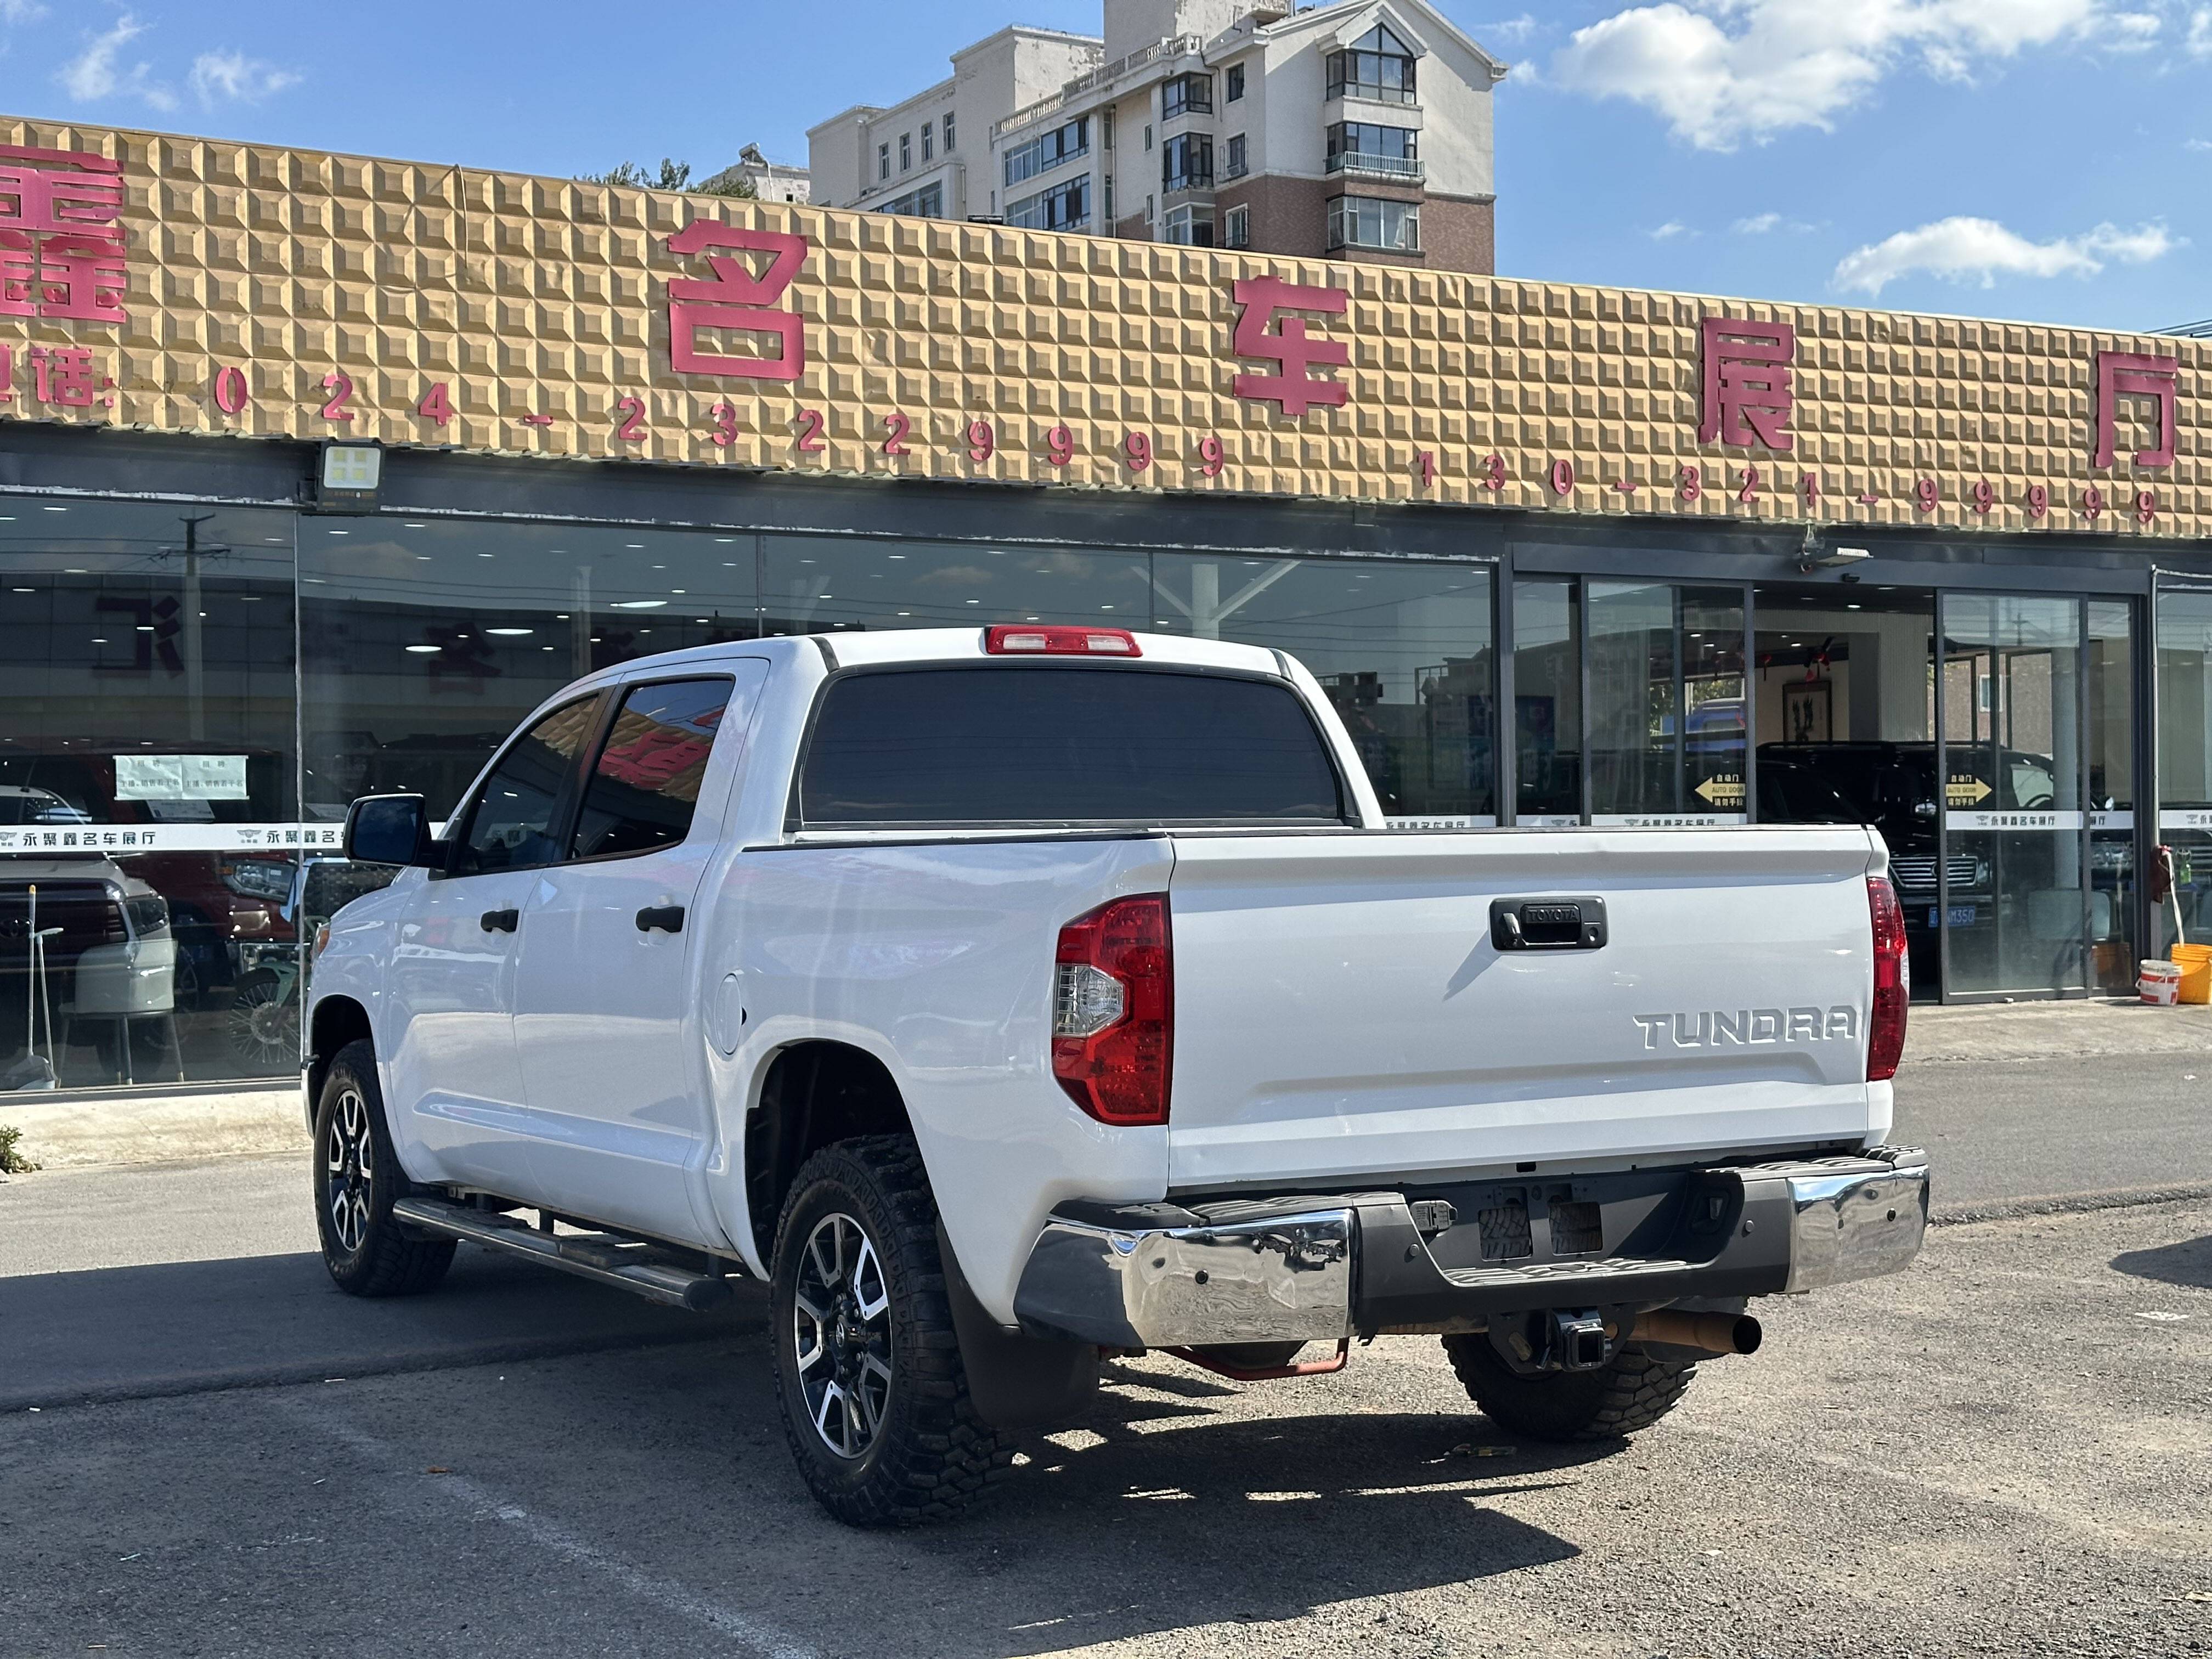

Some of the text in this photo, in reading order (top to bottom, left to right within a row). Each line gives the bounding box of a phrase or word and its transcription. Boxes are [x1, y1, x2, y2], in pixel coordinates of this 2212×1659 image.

[1717, 774, 1739, 782] 自动门
[22, 832, 156, 846] 永聚鑫名车展厅
[266, 830, 344, 843] 永聚鑫名
[1528, 909, 1578, 921] TOYOTA
[1632, 1005, 1857, 1049] TUNDRA
